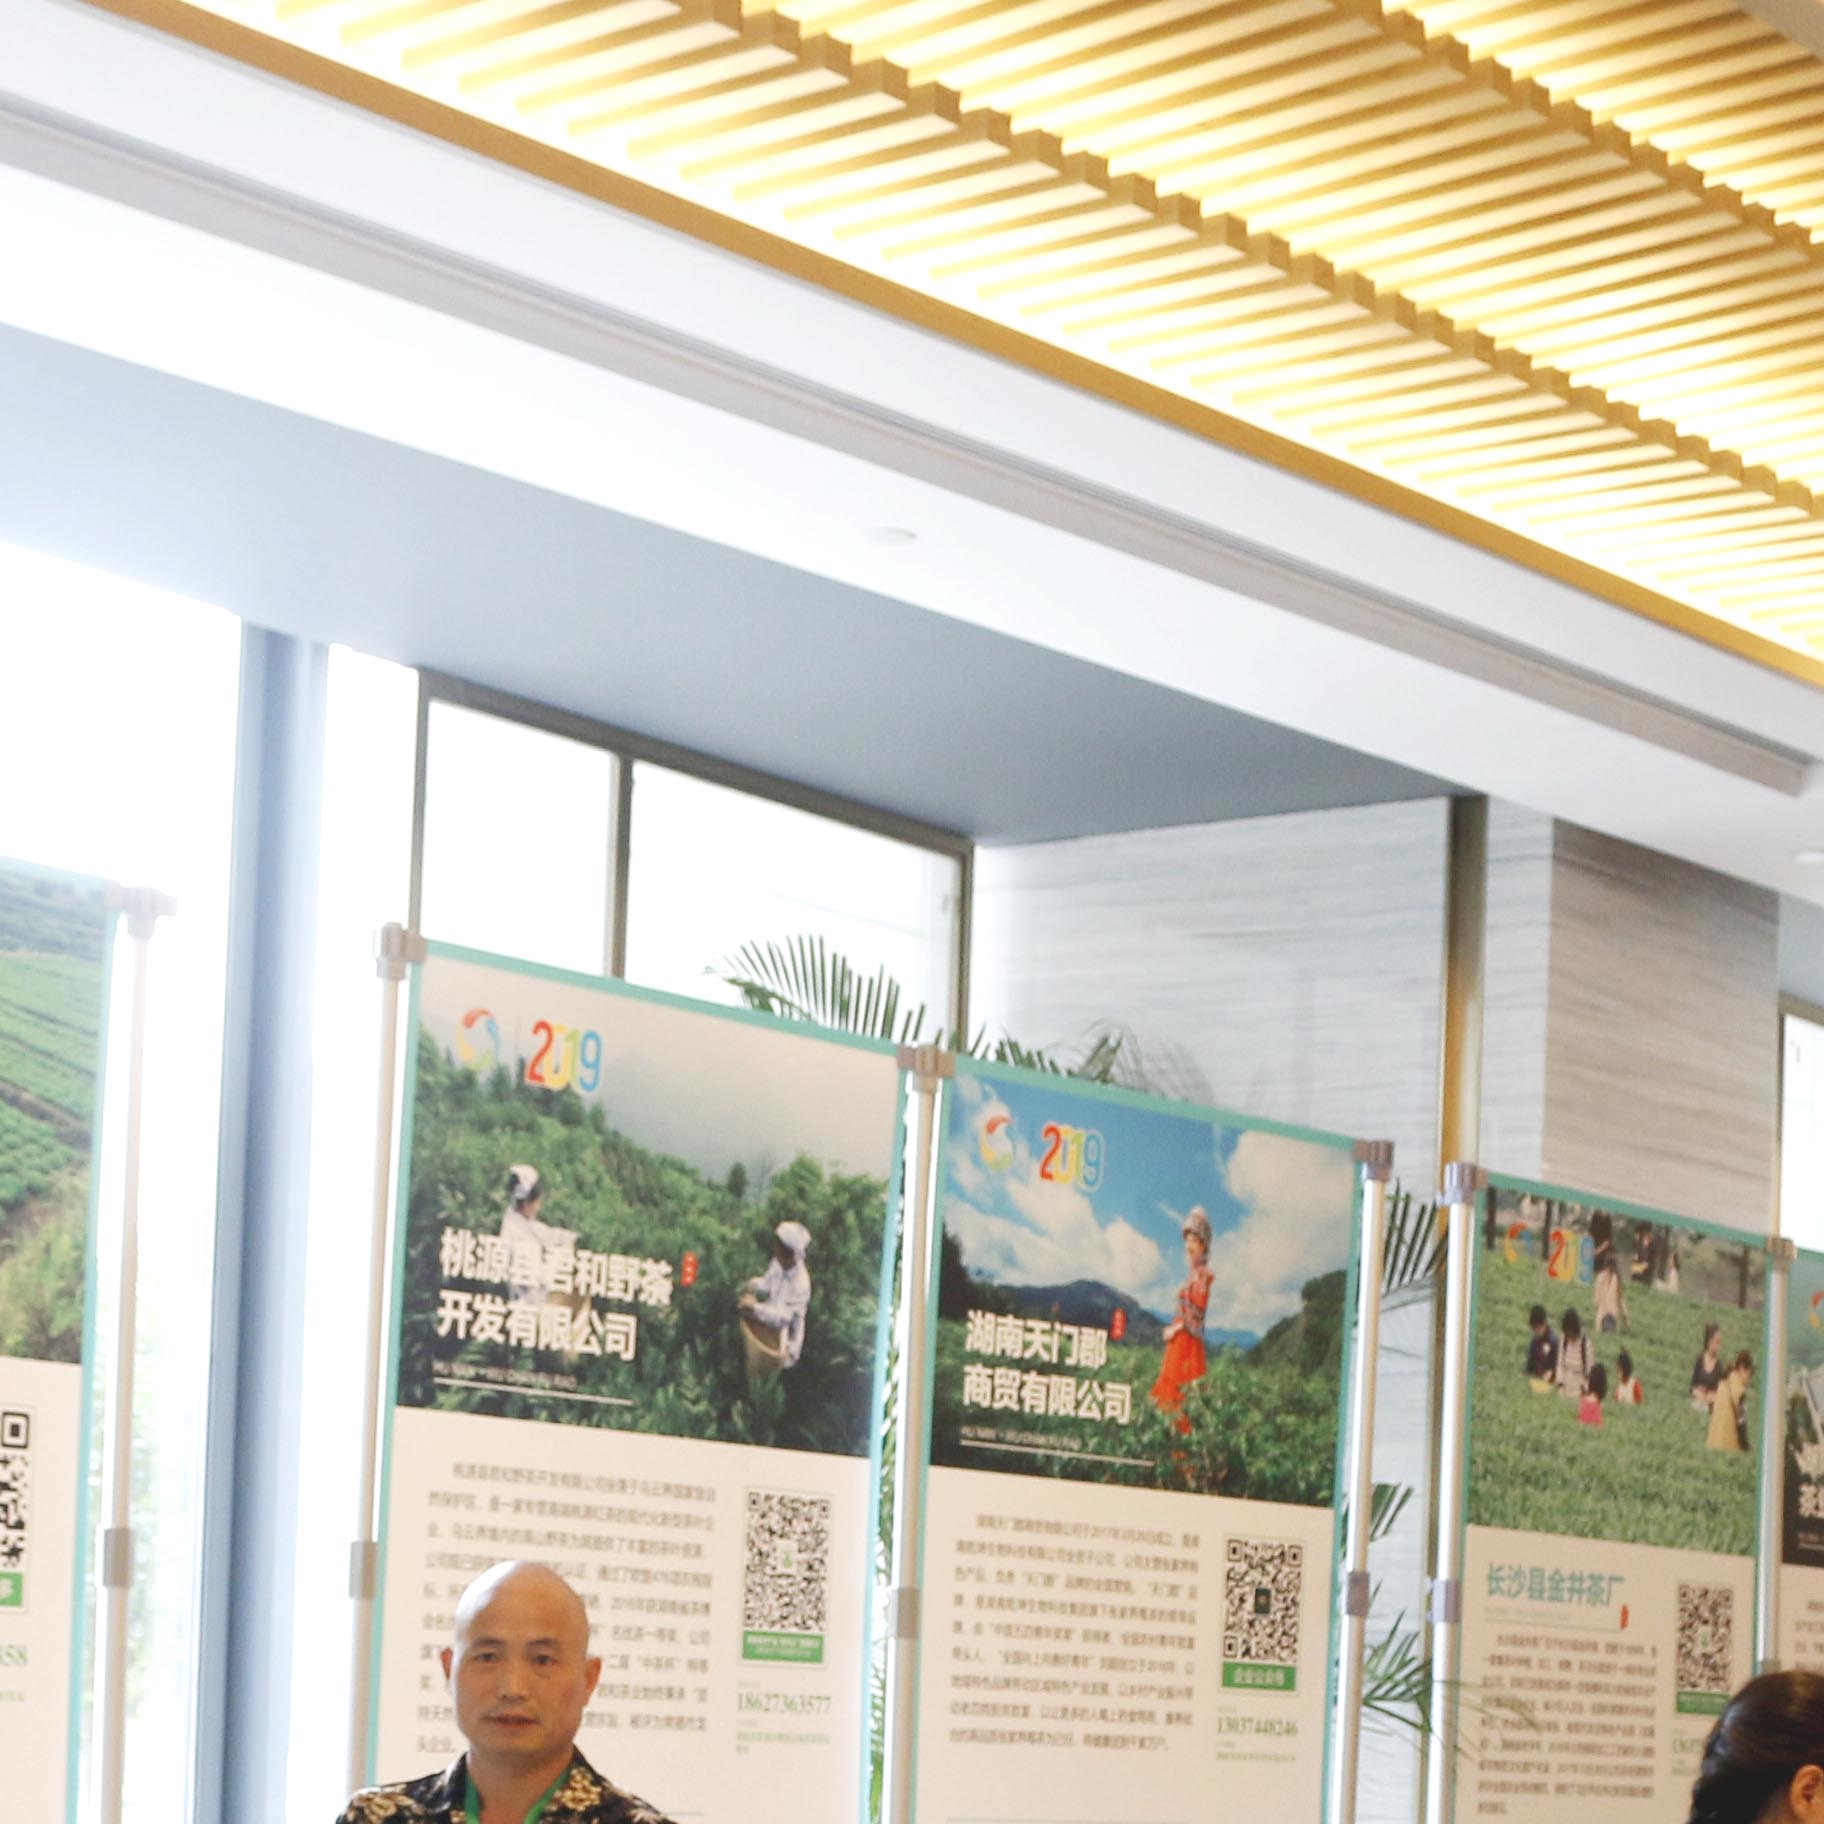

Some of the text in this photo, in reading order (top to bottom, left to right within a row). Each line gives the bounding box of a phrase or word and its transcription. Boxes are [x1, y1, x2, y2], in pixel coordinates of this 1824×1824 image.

[523, 1019, 604, 1093] 2019
[1039, 1121, 1106, 1192] 2019
[439, 1226, 674, 1308] 桃源县君和野茶
[1547, 1228, 1596, 1285] 2019
[435, 1290, 640, 1362] 开发有限公司
[965, 1309, 1109, 1371] 湖南天门郡
[962, 1364, 1134, 1426] 商贸有限公司
[1487, 1563, 1626, 1608] 长沙县金井茶厂
